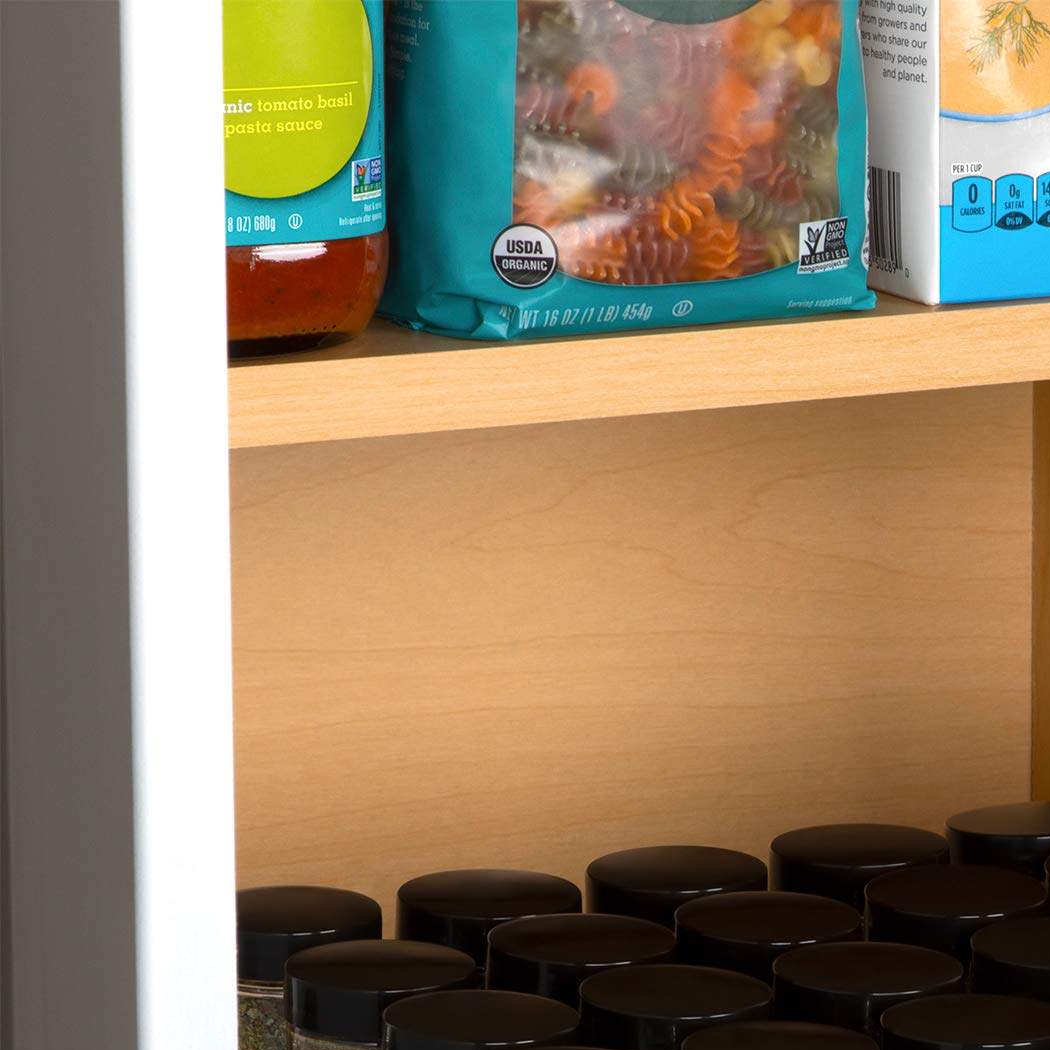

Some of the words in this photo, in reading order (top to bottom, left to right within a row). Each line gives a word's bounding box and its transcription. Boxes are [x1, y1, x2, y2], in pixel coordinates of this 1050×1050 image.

[879, 0, 896, 12] high
[897, 3, 928, 17] quality
[878, 17, 908, 30] growers
[909, 22, 927, 32] and
[872, 32, 887, 43] who
[888, 35, 910, 47] share
[911, 40, 927, 49] our
[871, 46, 896, 64] healthy
[897, 54, 928, 67] people
[882, 68, 896, 79] and
[897, 69, 928, 83] planet.
[257, 97, 313, 112] tomato
[317, 91, 353, 109] basil
[224, 120, 272, 138] pasta
[275, 119, 323, 132] sauce
[952, 165, 965, 173] PER
[970, 163, 982, 172] CUP
[968, 183, 978, 204] 0
[1009, 183, 1021, 199] 0g
[960, 207, 985, 216] CALORIES
[1003, 202, 1014, 210] SAT
[1015, 200, 1025, 209] FAT
[236, 216, 251, 233] OZ)
[254, 215, 276, 232] 680g
[828, 221, 845, 232] NON
[827, 230, 844, 241] GMO
[506, 240, 543, 254] USDA
[804, 249, 848, 264] VERIFIED
[502, 259, 548, 271] ORGANIC
[518, 309, 540, 329] WT
[543, 309, 558, 327] 16
[560, 306, 580, 326] OZ
[596, 304, 620, 323] LB)
[621, 302, 653, 321] 454g
